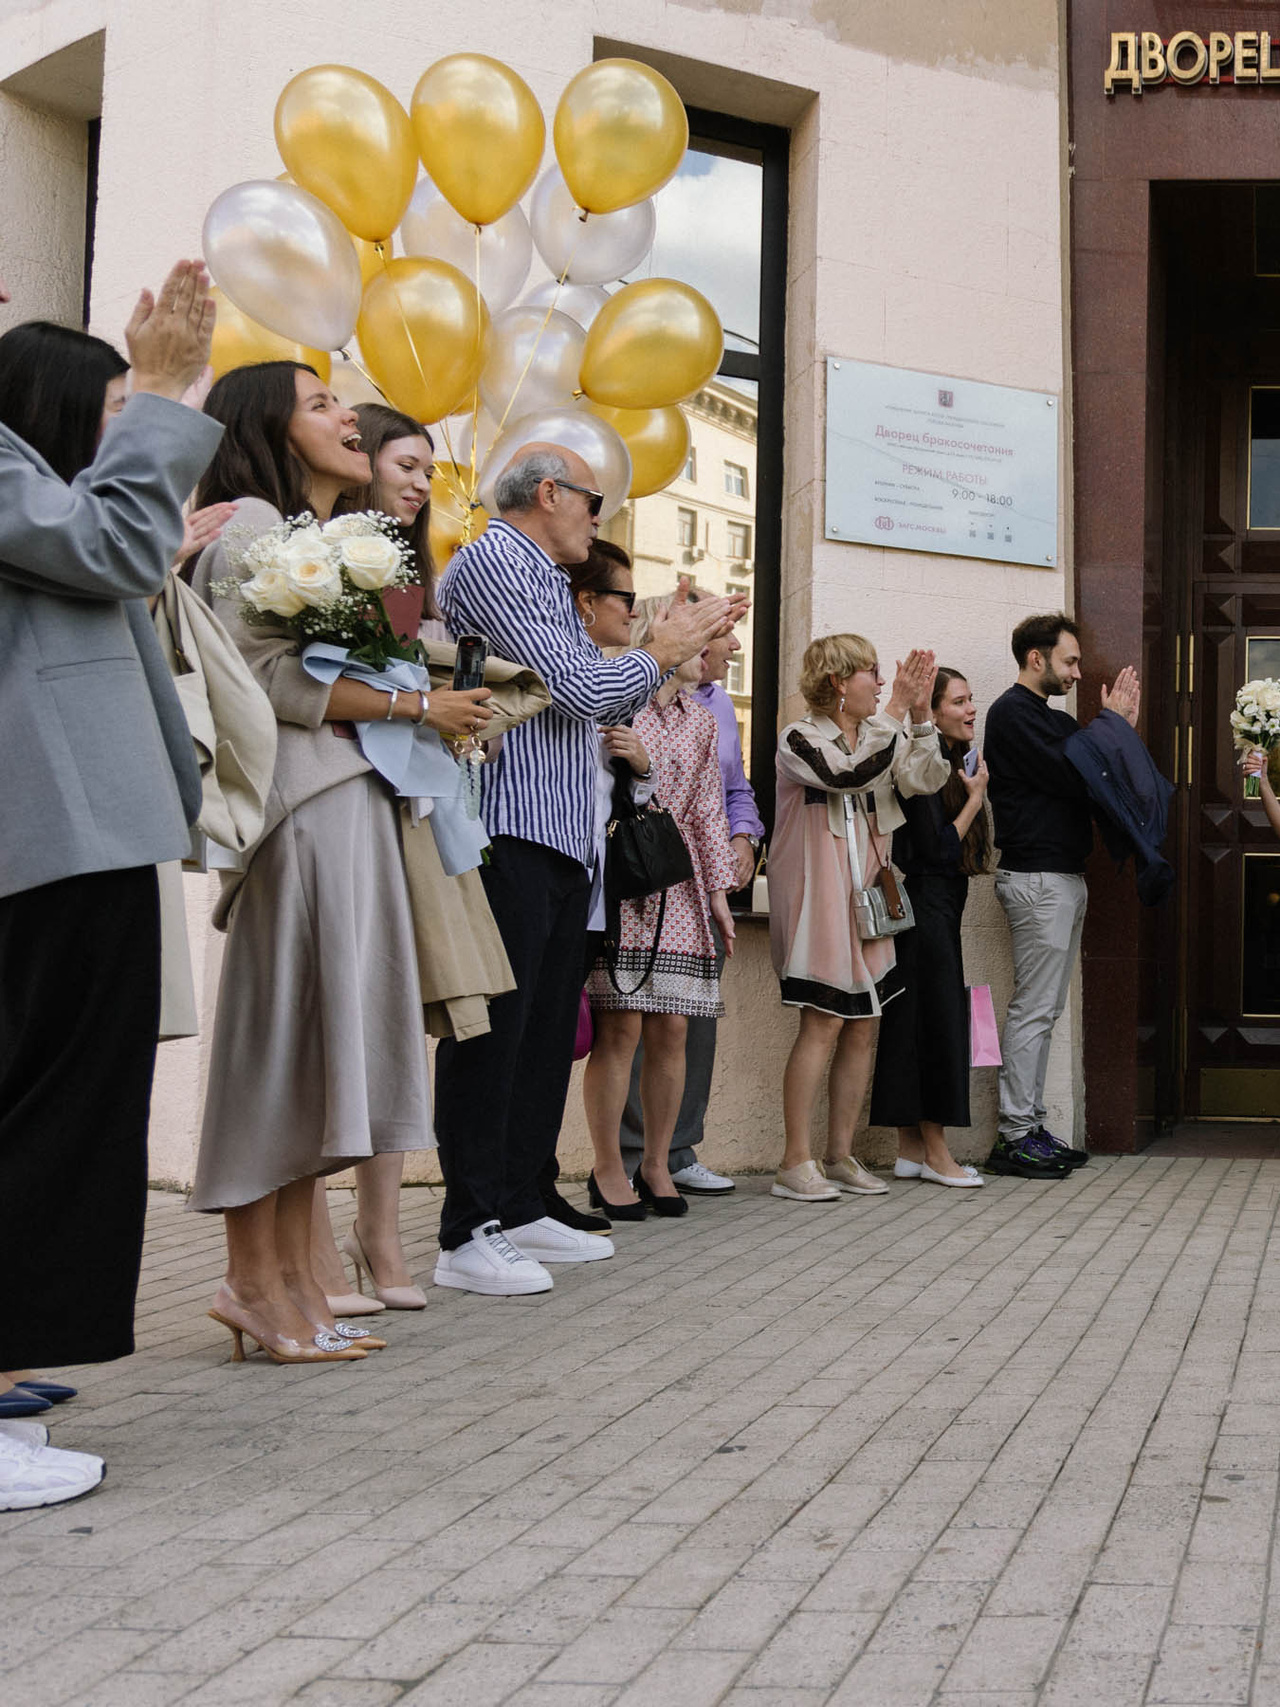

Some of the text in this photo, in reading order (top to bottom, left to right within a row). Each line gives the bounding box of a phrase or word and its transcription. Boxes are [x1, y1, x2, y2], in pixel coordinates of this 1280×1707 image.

[875, 424, 920, 444] Дворец
[922, 432, 1014, 456] бракосочетания
[902, 463, 987, 485] РЕЖИМ РАБОТЫ
[986, 493, 1013, 506] 18:00
